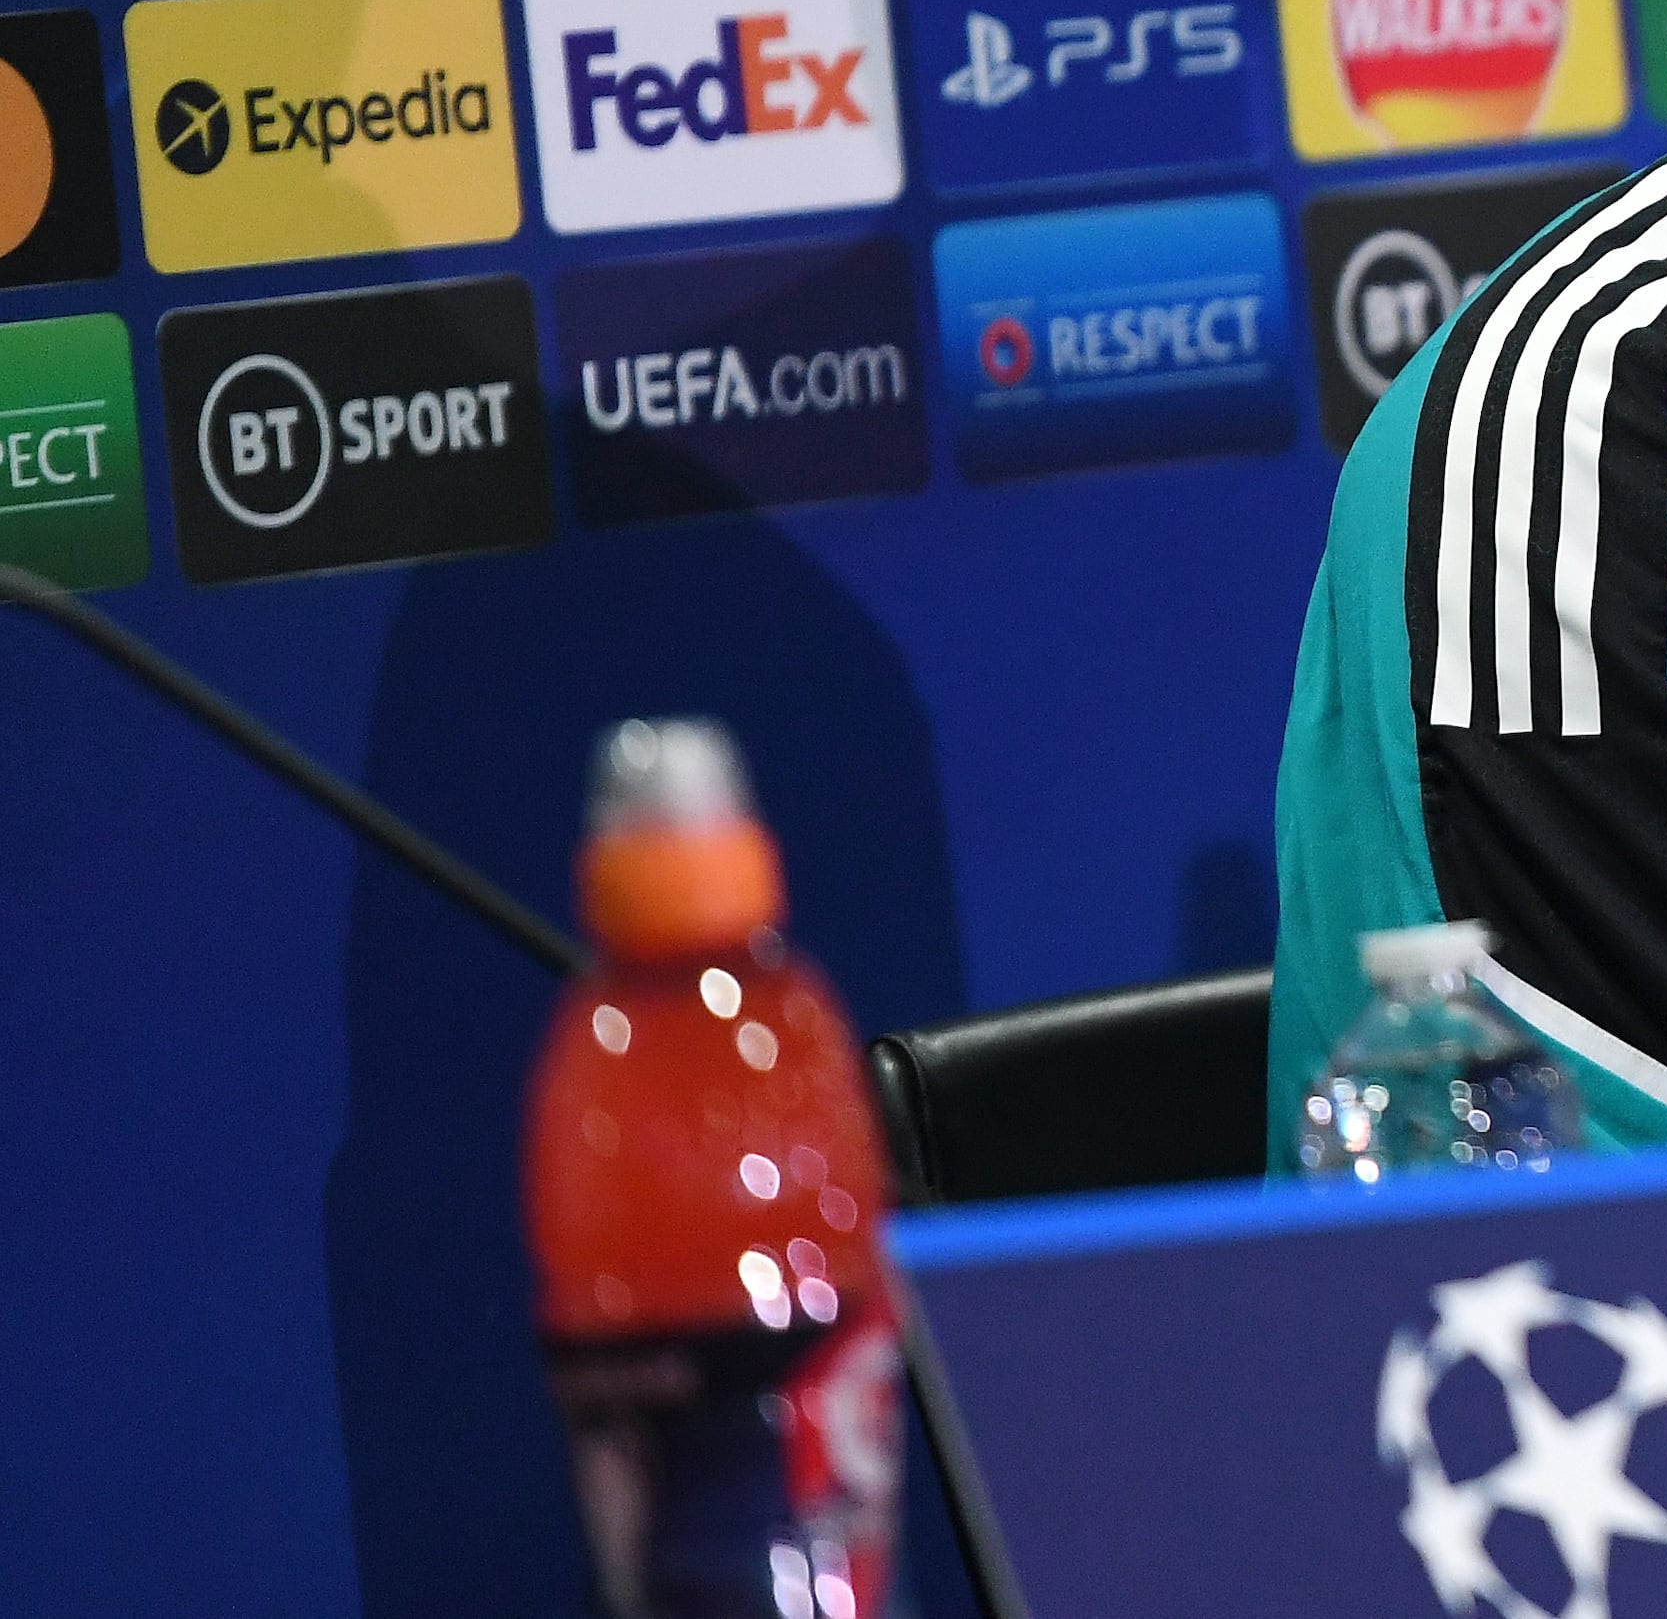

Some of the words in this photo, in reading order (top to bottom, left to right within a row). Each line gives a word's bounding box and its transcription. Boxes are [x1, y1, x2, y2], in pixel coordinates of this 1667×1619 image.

[561, 12, 870, 152] FedEx
[1045, 3, 1244, 86] PS5
[243, 68, 491, 164] Expedia
[1047, 295, 1262, 378] RESPECT
[228, 406, 301, 476] BT
[339, 382, 511, 465] SPORT
[582, 344, 905, 431] UEFA.com
